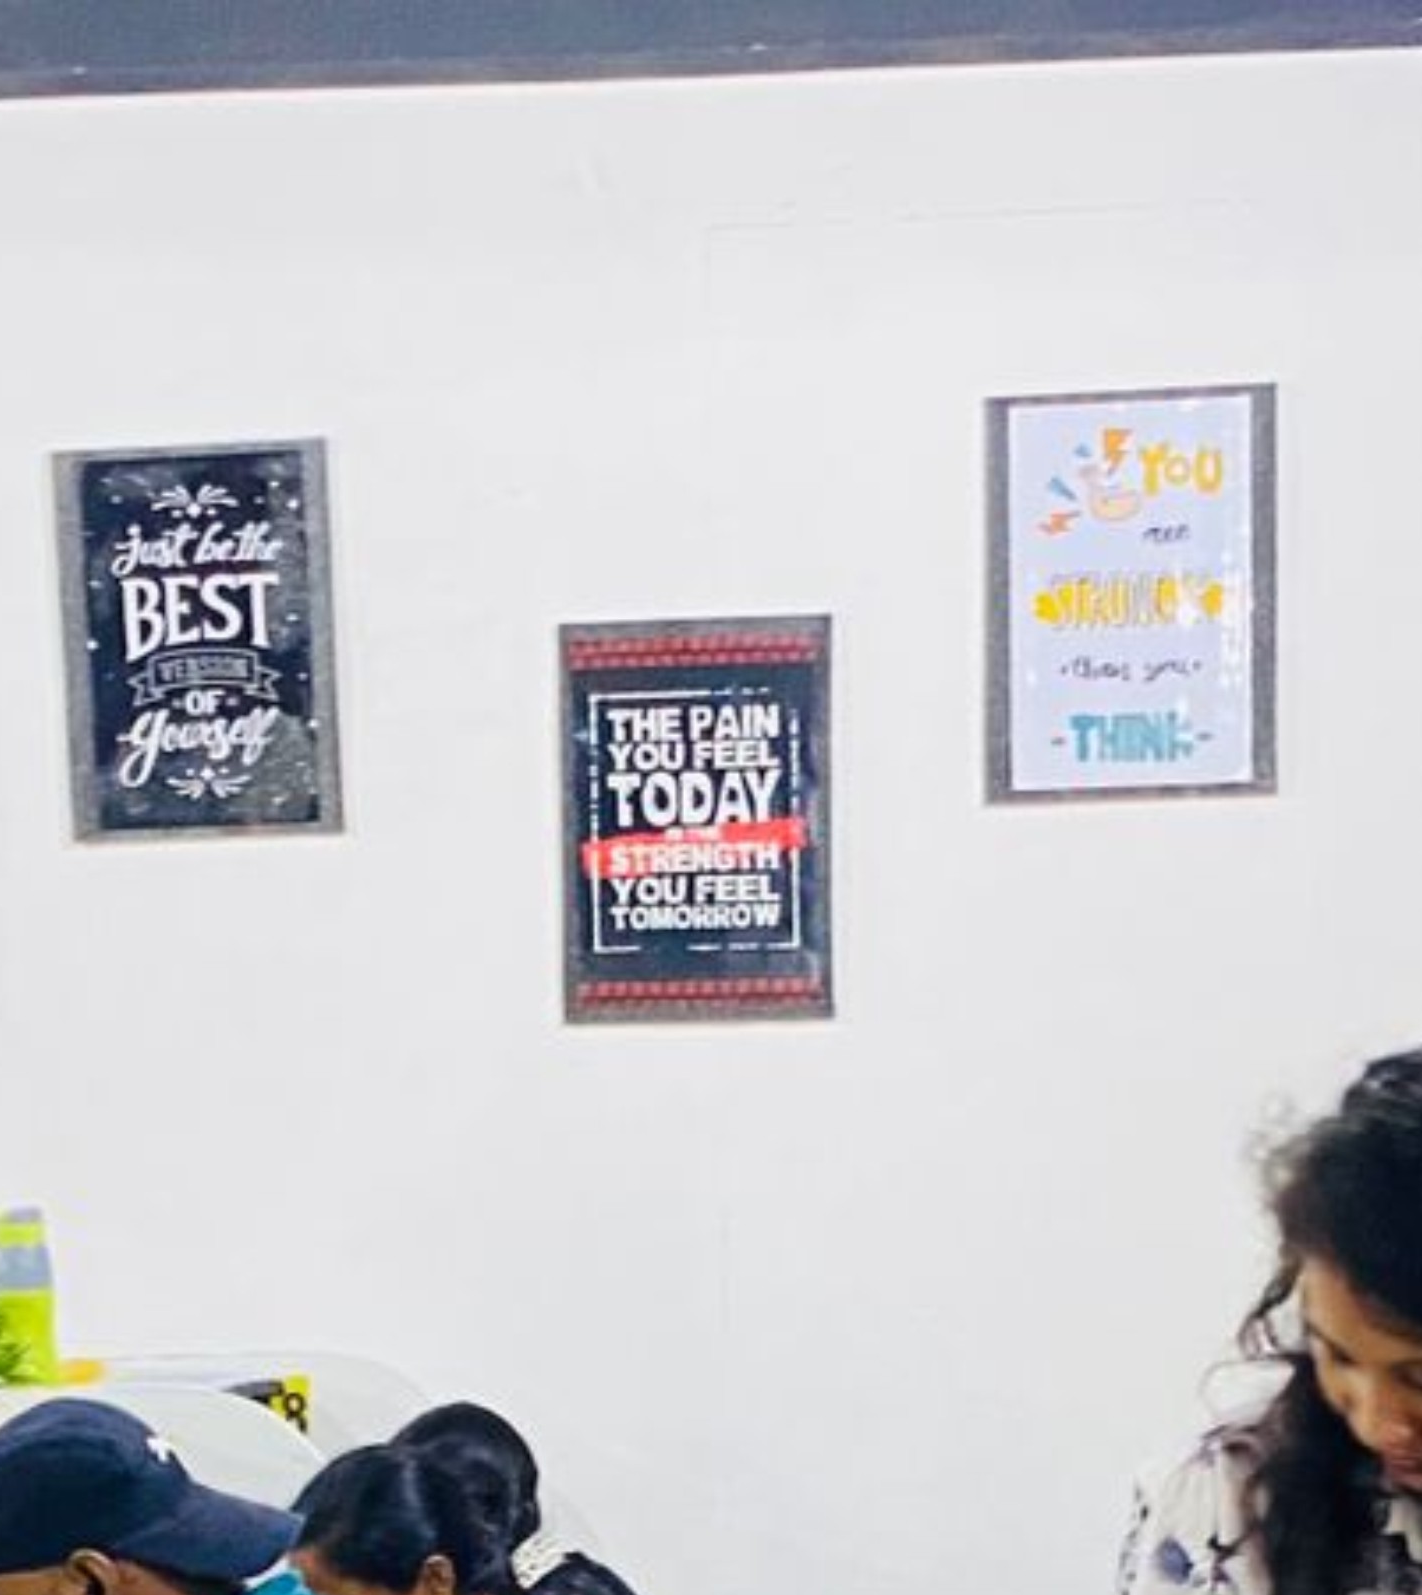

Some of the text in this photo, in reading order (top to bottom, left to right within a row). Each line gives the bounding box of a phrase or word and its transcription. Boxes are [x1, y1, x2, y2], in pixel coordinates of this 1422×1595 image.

[1138, 439, 1223, 496] YOU
[120, 572, 280, 663] BEST
[185, 689, 227, 716] OF
[606, 704, 779, 743] THE PAIN
[610, 740, 780, 771] YOU FEEL
[607, 768, 782, 828] TODAY
[608, 841, 780, 874] STRENGTH
[610, 874, 780, 905] YOU FEEL
[610, 902, 781, 931] TOMORROW
